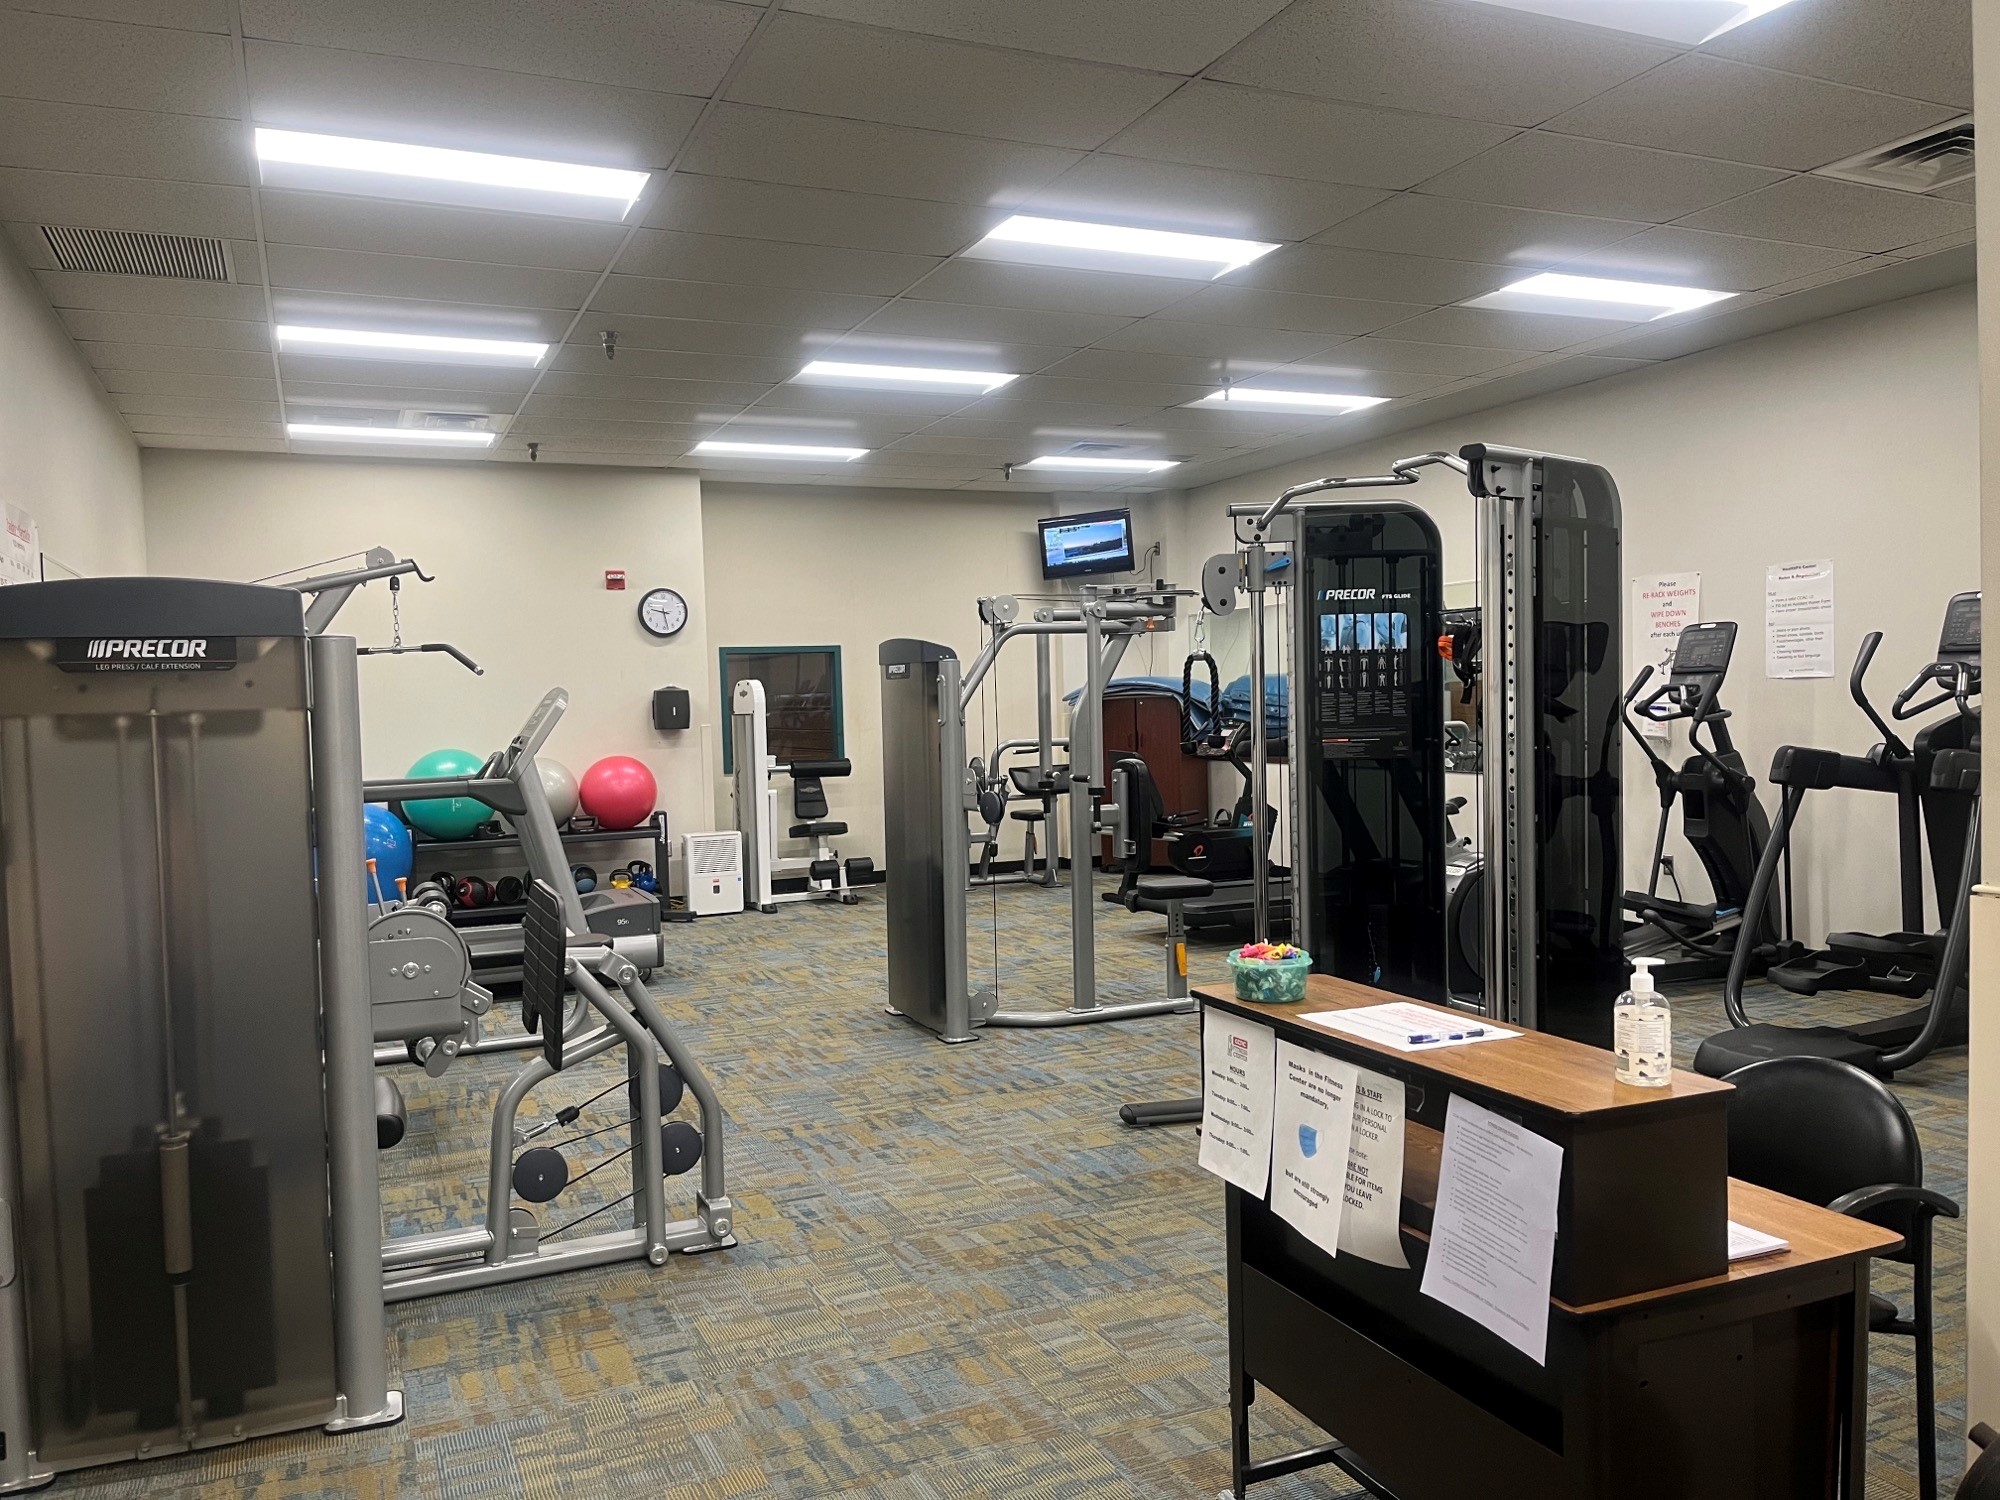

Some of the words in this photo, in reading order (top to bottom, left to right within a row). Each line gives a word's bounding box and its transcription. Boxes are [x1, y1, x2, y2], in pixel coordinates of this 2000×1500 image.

[1326, 588, 1375, 600] PRECOR
[1667, 588, 1696, 597] WEIGHTS
[105, 640, 207, 658] PRECOR
[1230, 1065, 1245, 1076] HOURS
[1289, 1061, 1306, 1073] Masks
[1314, 1071, 1323, 1080] the
[1324, 1075, 1343, 1090] Fitness
[1289, 1073, 1307, 1086] Center
[1308, 1082, 1316, 1090] are
[1325, 1089, 1341, 1102] longer
[1367, 1089, 1382, 1100] STAFF
[1371, 1108, 1384, 1119] LOCK
[1385, 1113, 1392, 1122] TO
[1362, 1116, 1387, 1133] PERSONAL
[1358, 1164, 1368, 1175] NOT
[1285, 1169, 1293, 1179] but
[1311, 1186, 1330, 1204] strongly
[1355, 1175, 1366, 1186] FOR
[1367, 1181, 1383, 1194] ITEMS
[1356, 1188, 1372, 1201] LEAVE
